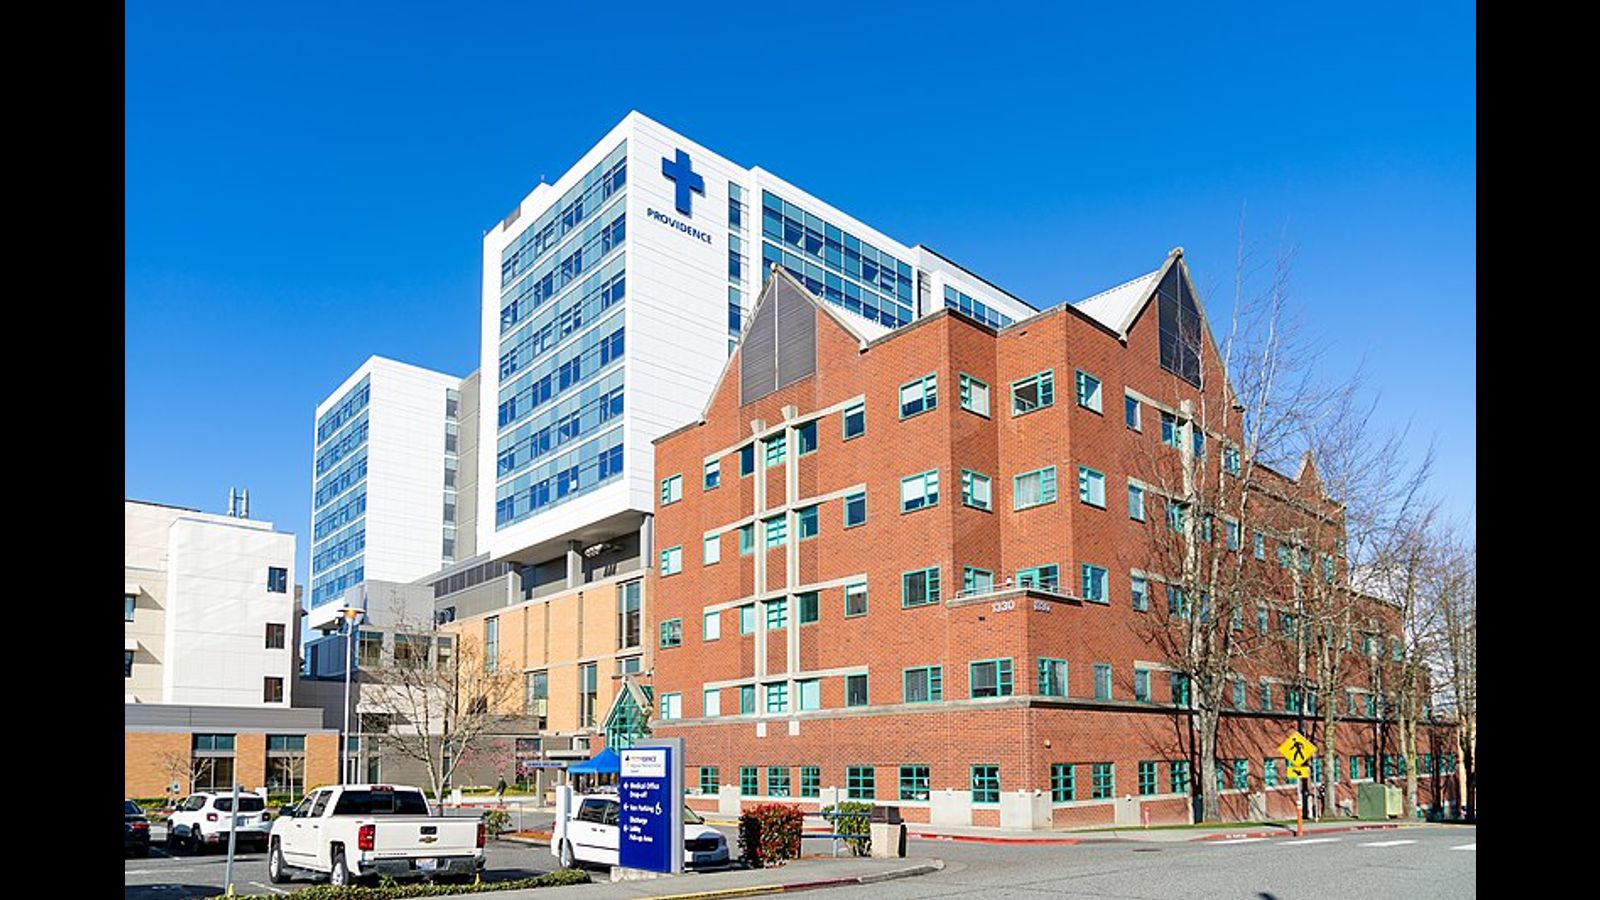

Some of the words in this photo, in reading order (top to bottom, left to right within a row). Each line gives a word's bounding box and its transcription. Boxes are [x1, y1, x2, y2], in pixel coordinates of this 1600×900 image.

[647, 208, 711, 244] PROVIDENCE
[630, 782, 646, 790] Medical
[647, 782, 660, 790] Office
